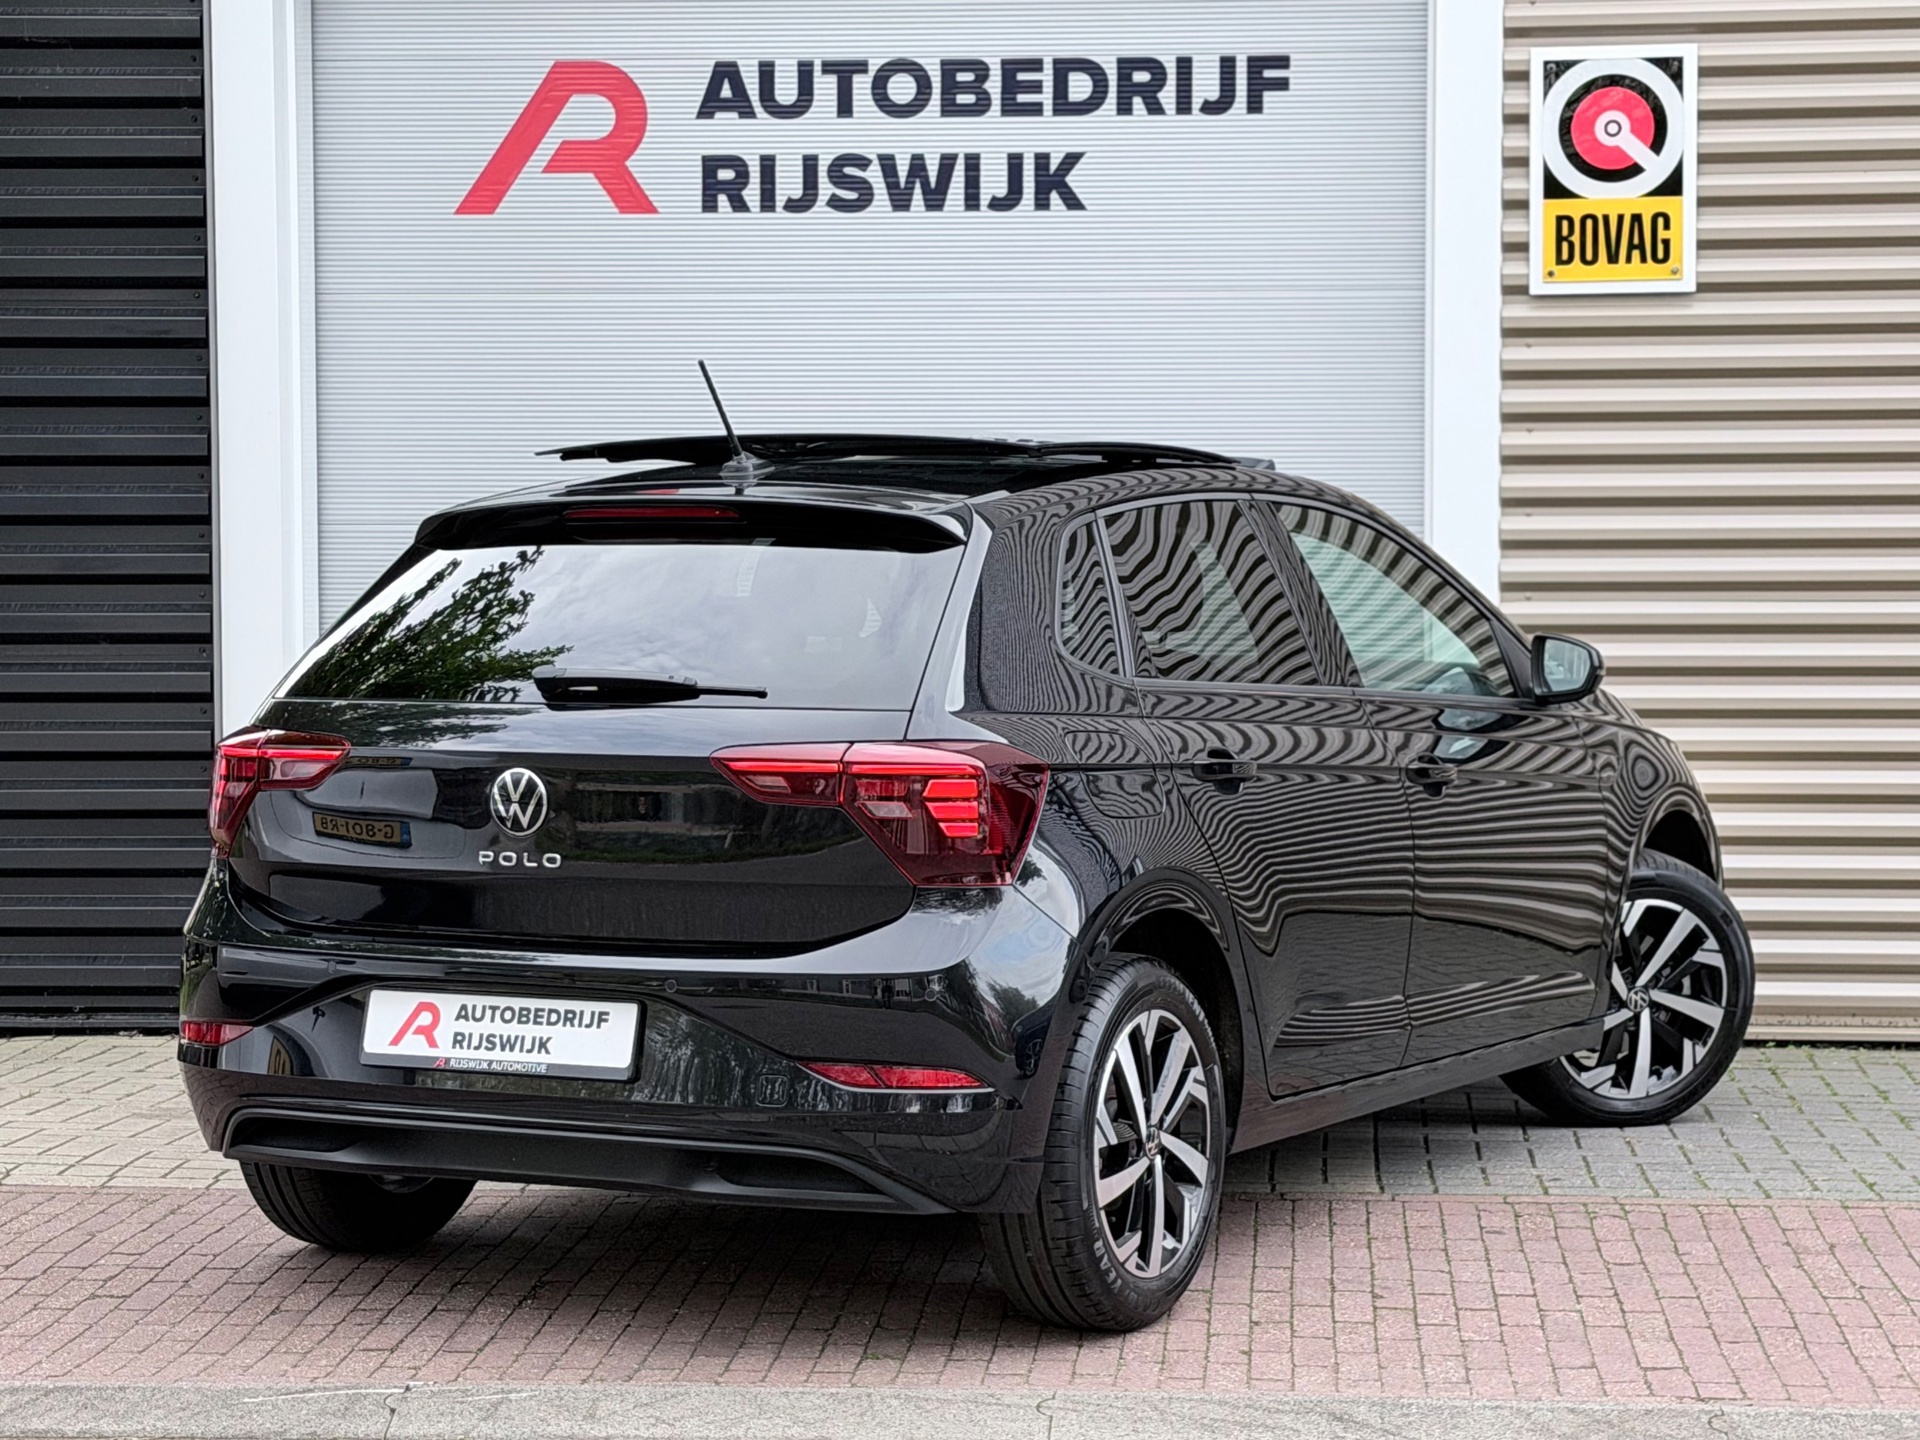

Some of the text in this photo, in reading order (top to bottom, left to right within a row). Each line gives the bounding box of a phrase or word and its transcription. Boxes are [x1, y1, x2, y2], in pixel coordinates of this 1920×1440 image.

[694, 54, 1292, 120] AUTOBEDRIJF
[700, 151, 1088, 214] RIJSWIJK
[1554, 211, 1672, 267] BOVAG
[478, 850, 562, 869] POLO
[454, 1003, 611, 1030] AUTOBEDRIJF
[451, 1031, 554, 1056] RIJSWIJK
[449, 1058, 490, 1070] RIJSWIJK
[490, 1061, 548, 1074] AUTOMOTIVE
